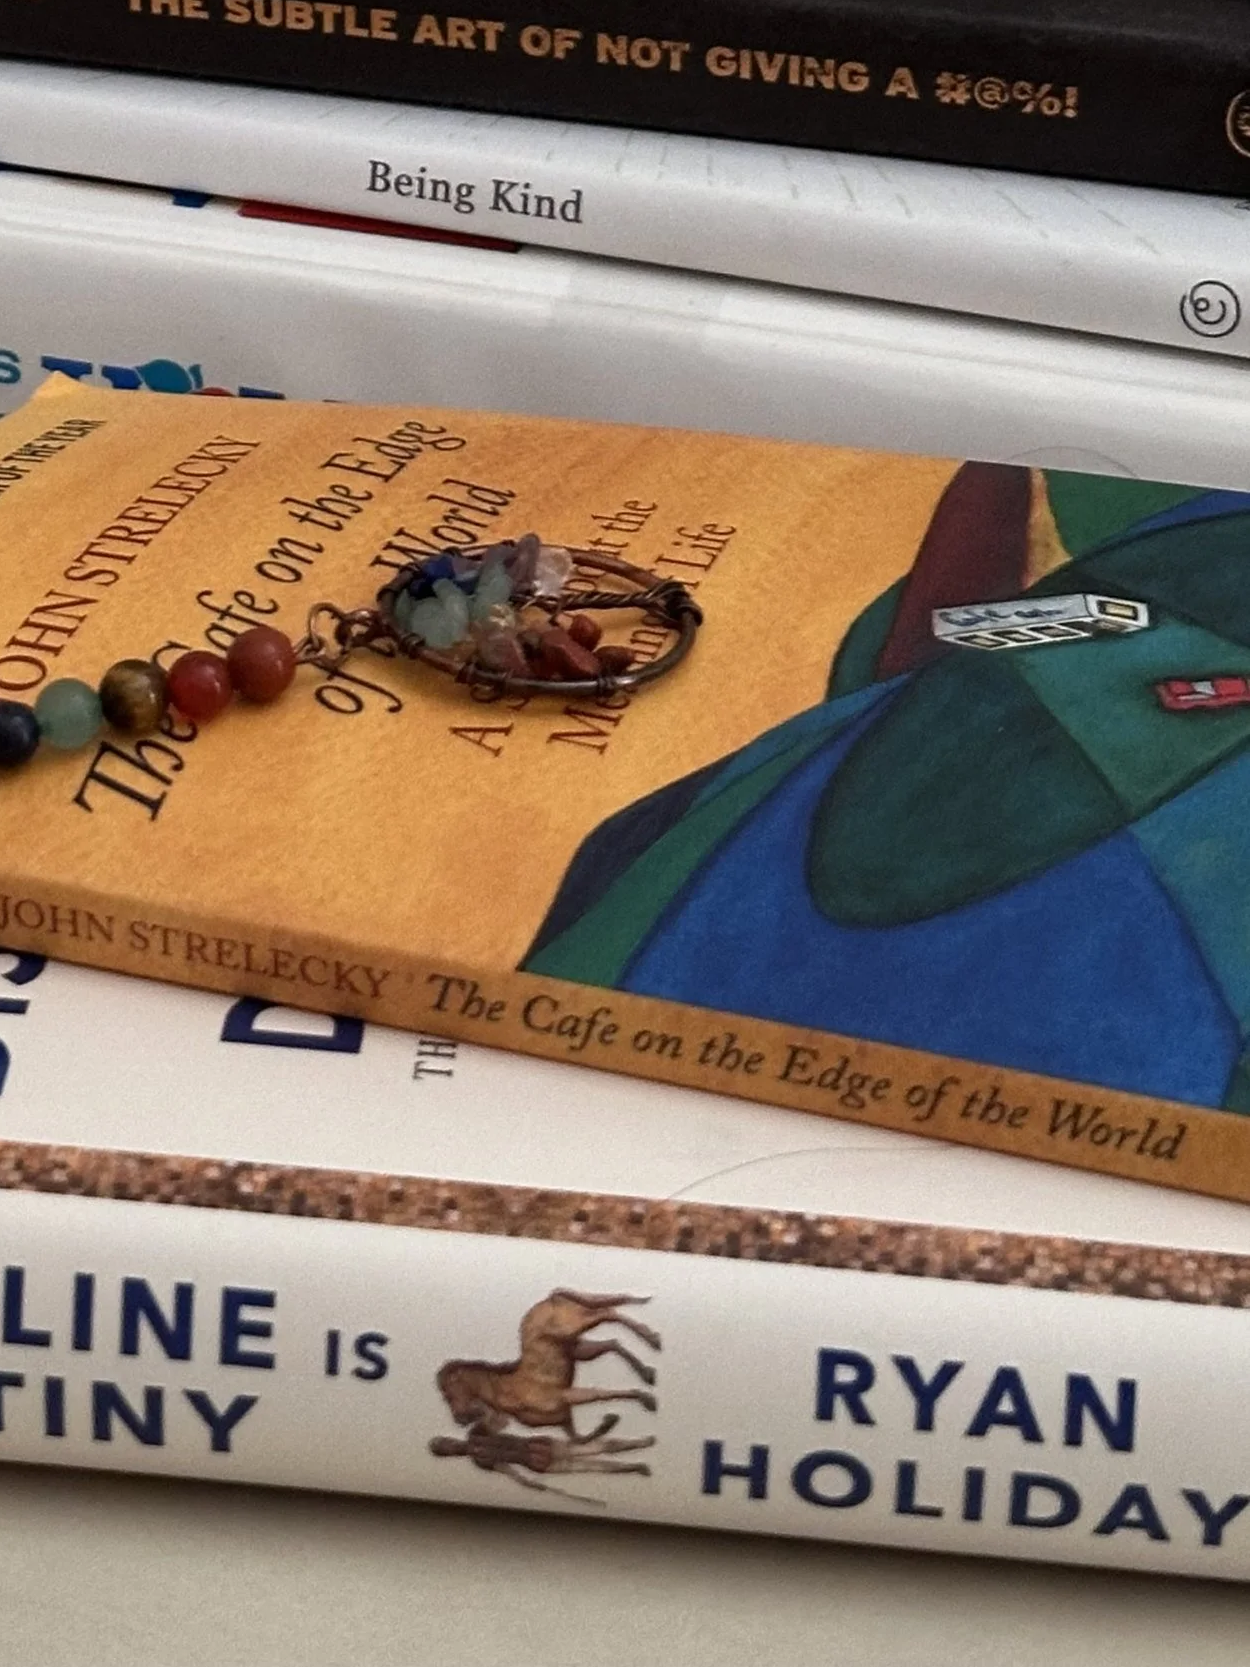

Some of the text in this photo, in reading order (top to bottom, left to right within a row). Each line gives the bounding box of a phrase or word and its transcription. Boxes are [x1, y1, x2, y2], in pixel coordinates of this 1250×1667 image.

[410, 18, 502, 54] ART
[520, 28, 580, 60] OF
[596, 36, 690, 72] NOT
[706, 48, 870, 92] GIVING
[884, 66, 920, 100] A
[368, 160, 584, 223] Being Kind
[1, 441, 66, 463] THE
[34, 418, 108, 442] YEAR
[320, 421, 466, 483] Edge
[63, 434, 261, 587] STRELECKY
[280, 484, 374, 532] the
[255, 537, 324, 583] on
[655, 524, 737, 571] Life
[449, 723, 514, 758] A
[592, 500, 657, 533] the
[310, 660, 403, 714] of
[128, 922, 392, 998] STRELECKY
[429, 972, 506, 1022] The
[522, 994, 620, 1050] Cafe
[633, 1026, 684, 1060] on
[699, 1032, 762, 1076] the
[778, 1044, 891, 1108] Edge
[906, 1076, 956, 1121] of
[961, 1086, 1030, 1130] the
[1047, 1098, 1188, 1164] World
[323, 1329, 390, 1381] IS
[815, 1347, 1139, 1453] RYAN
[702, 1440, 1250, 1548] HOLIDAY
